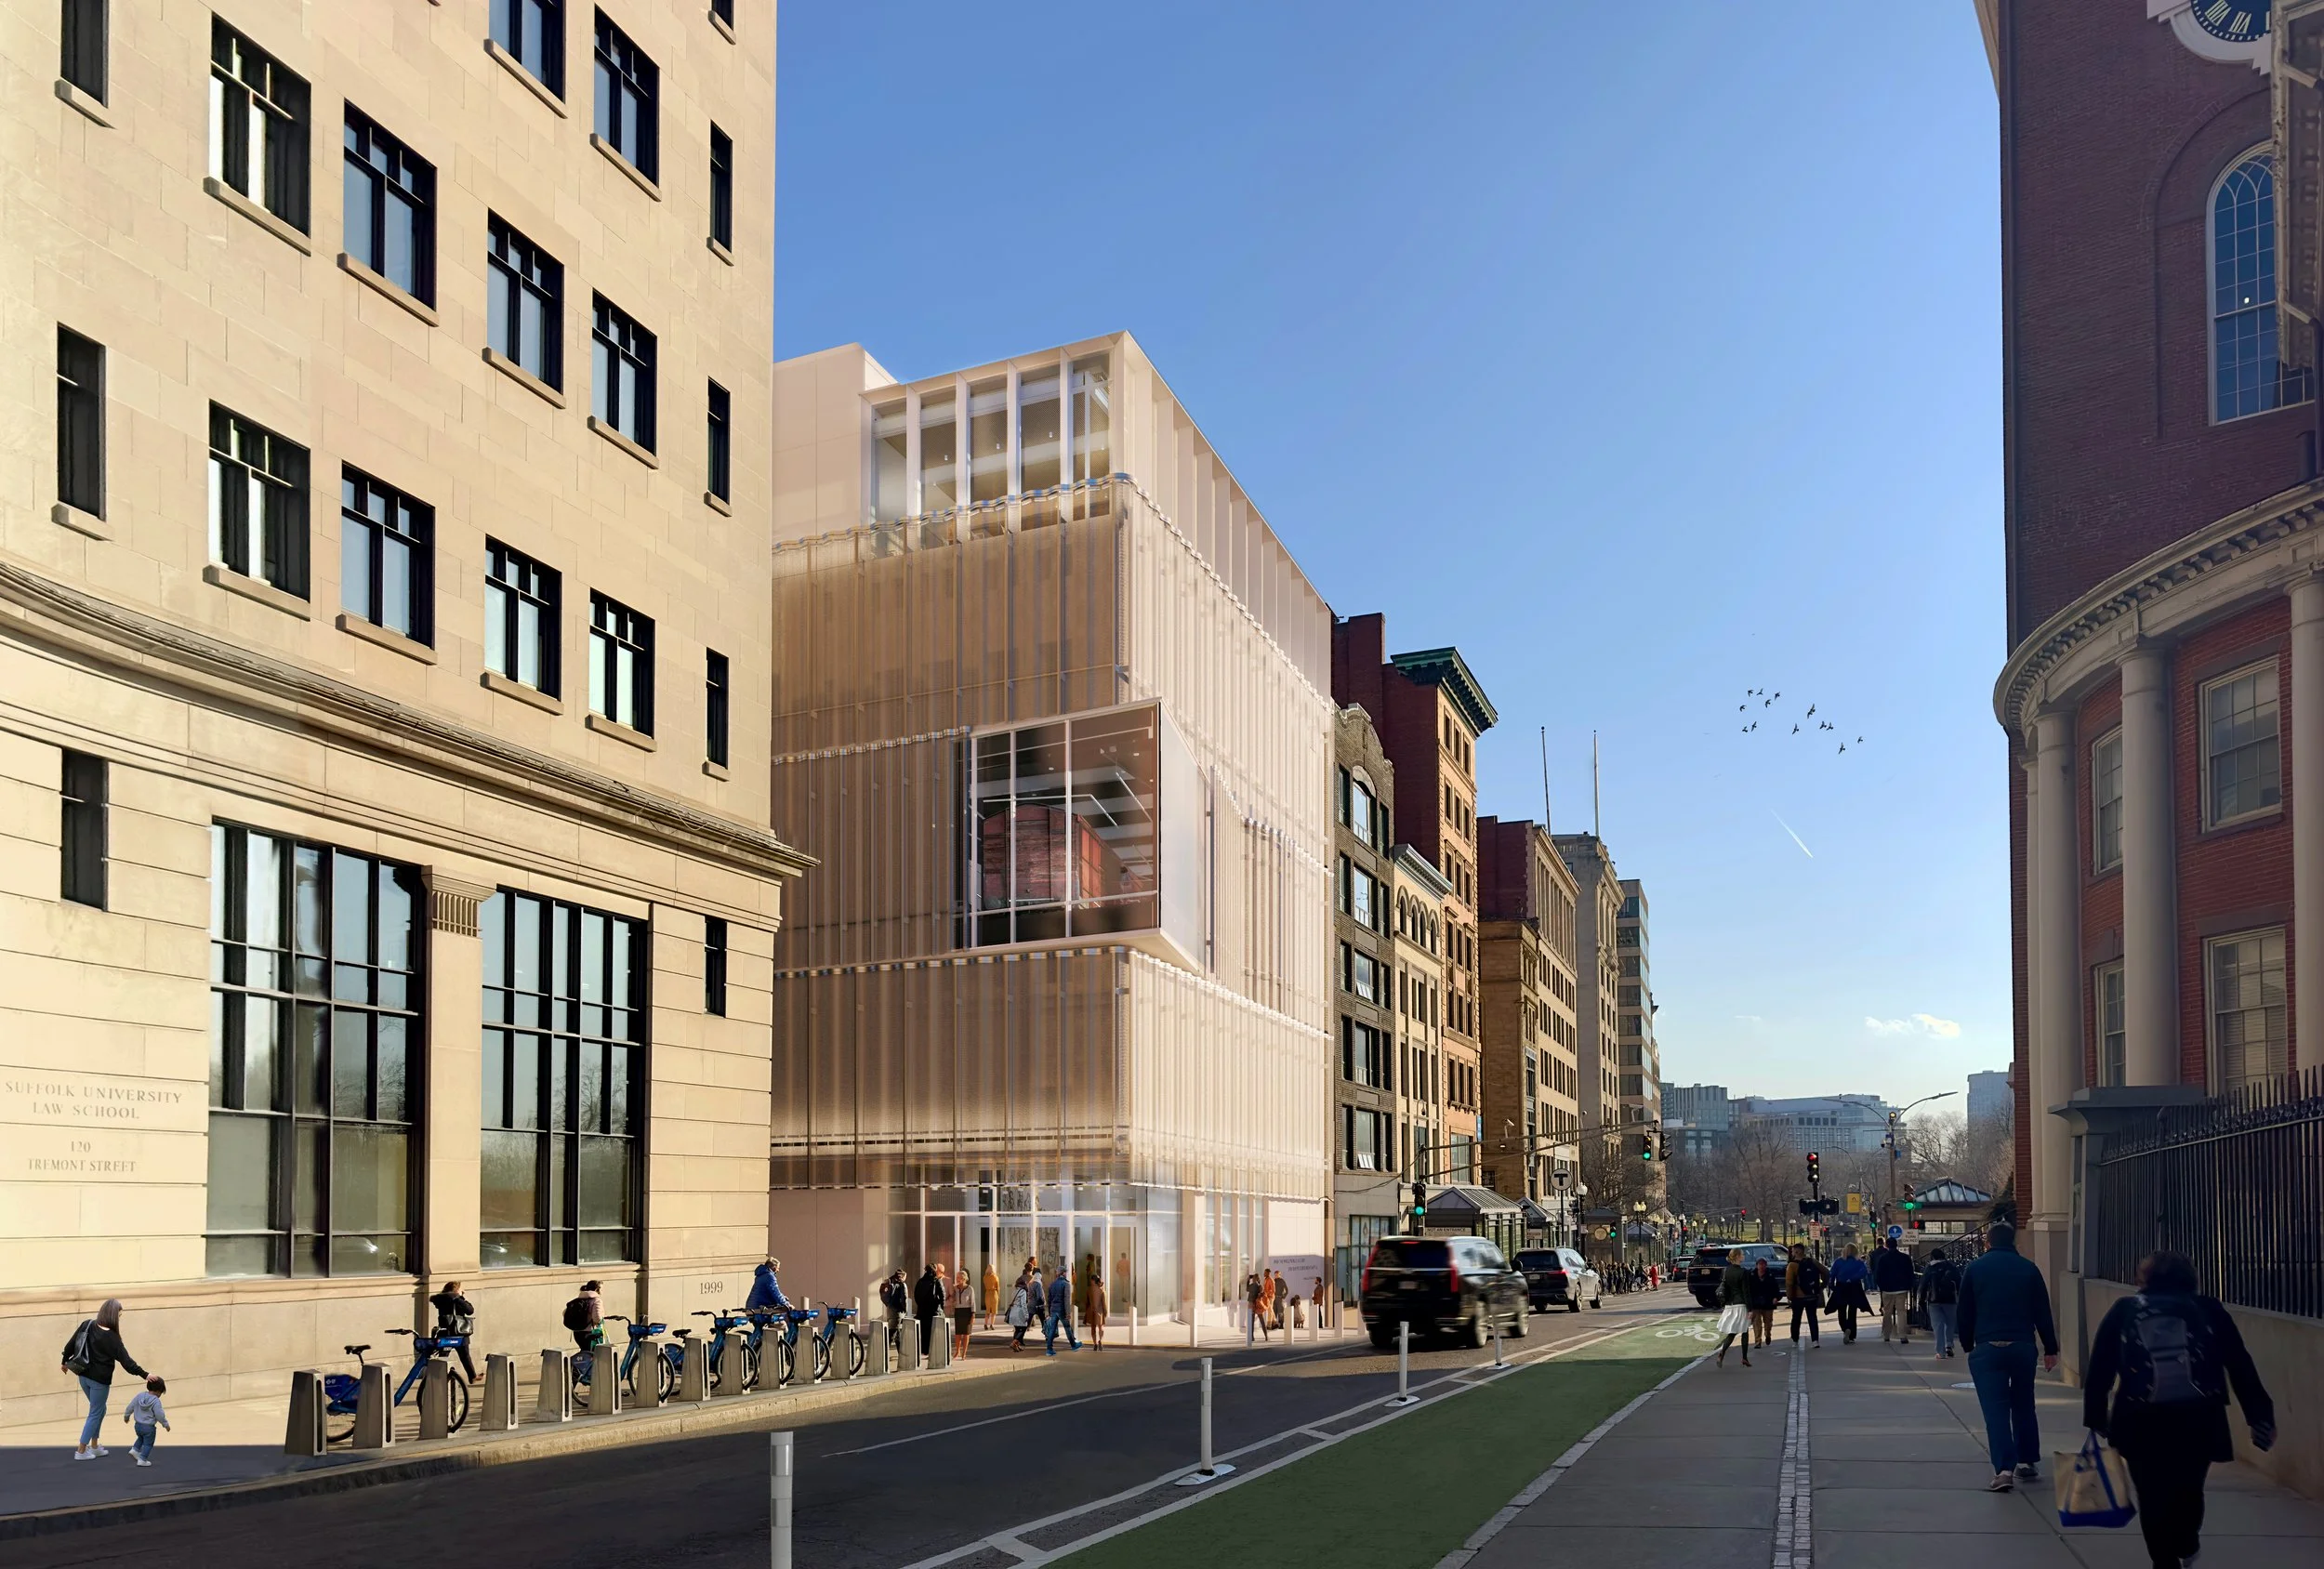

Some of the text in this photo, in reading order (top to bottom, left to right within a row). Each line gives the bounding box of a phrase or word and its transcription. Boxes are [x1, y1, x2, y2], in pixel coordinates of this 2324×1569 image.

[6, 1081, 182, 1103] SUFFOLK UNIVERSITY
[33, 1101, 139, 1119] LAW SCHOOL
[71, 1140, 91, 1153] 120
[28, 1158, 137, 1172] TREMONT STREET
[1554, 1174, 1568, 1186] T
[700, 1281, 723, 1294] 1999
